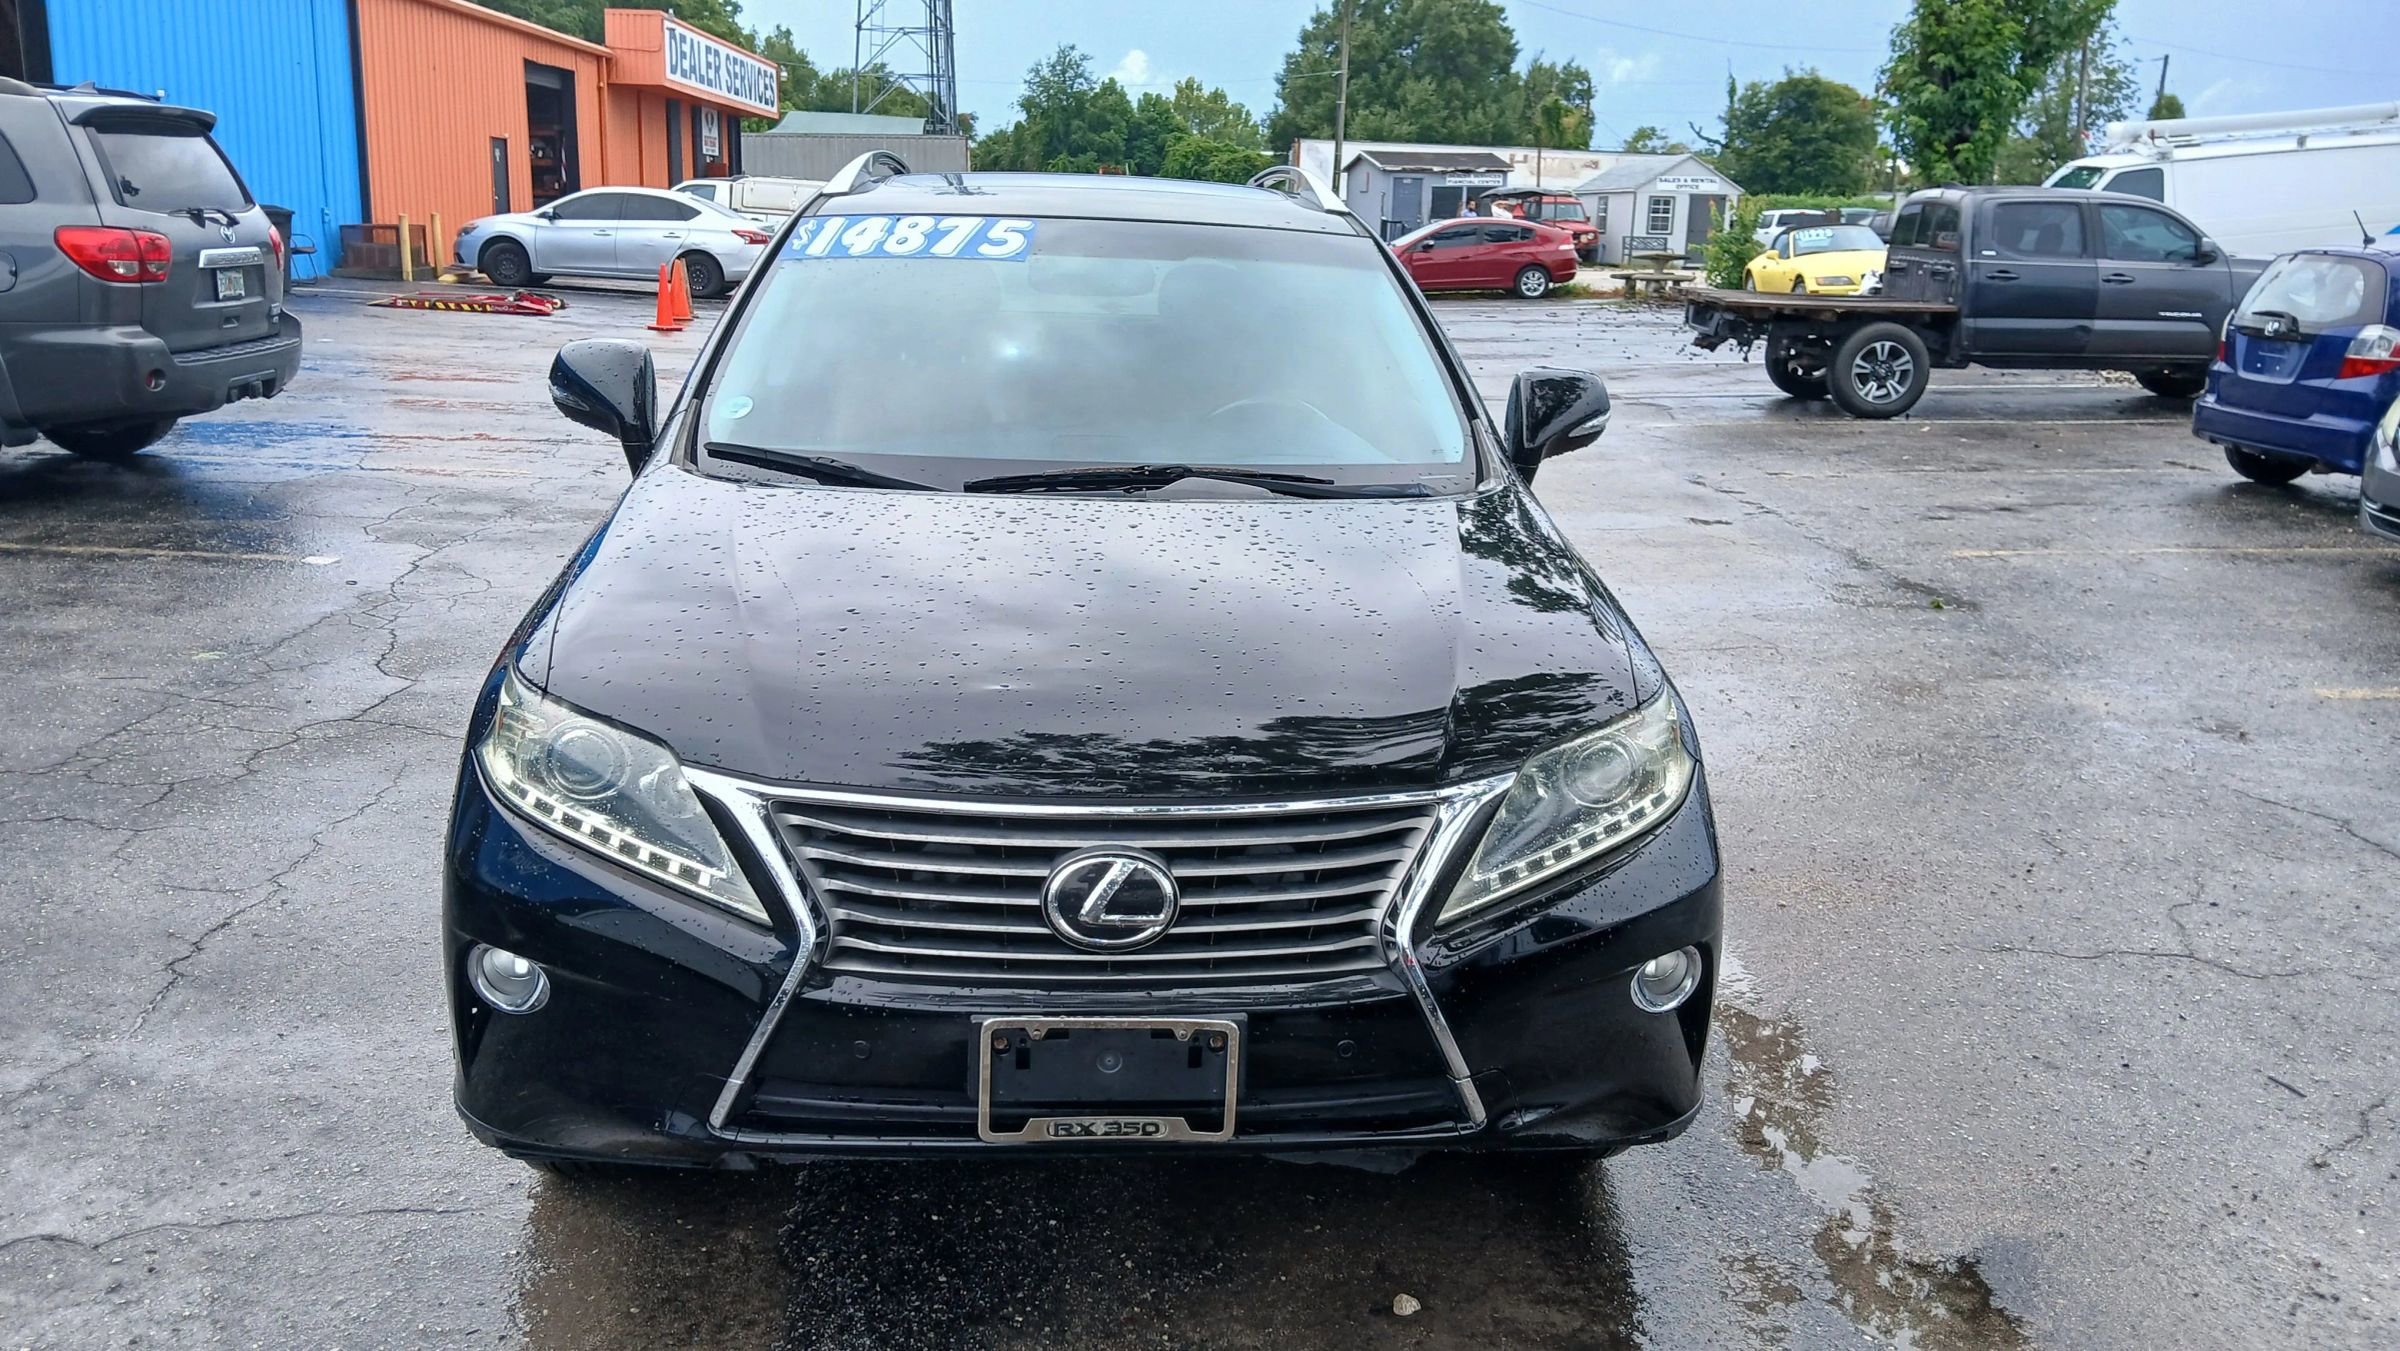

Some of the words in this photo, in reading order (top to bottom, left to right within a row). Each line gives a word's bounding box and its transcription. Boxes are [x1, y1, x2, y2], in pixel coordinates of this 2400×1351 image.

[667, 27, 722, 91] DEALER
[725, 53, 776, 108] SERVICES
[791, 216, 1035, 258] $14875
[1054, 1122, 1099, 1137] RX
[1103, 1121, 1160, 1137] 350
